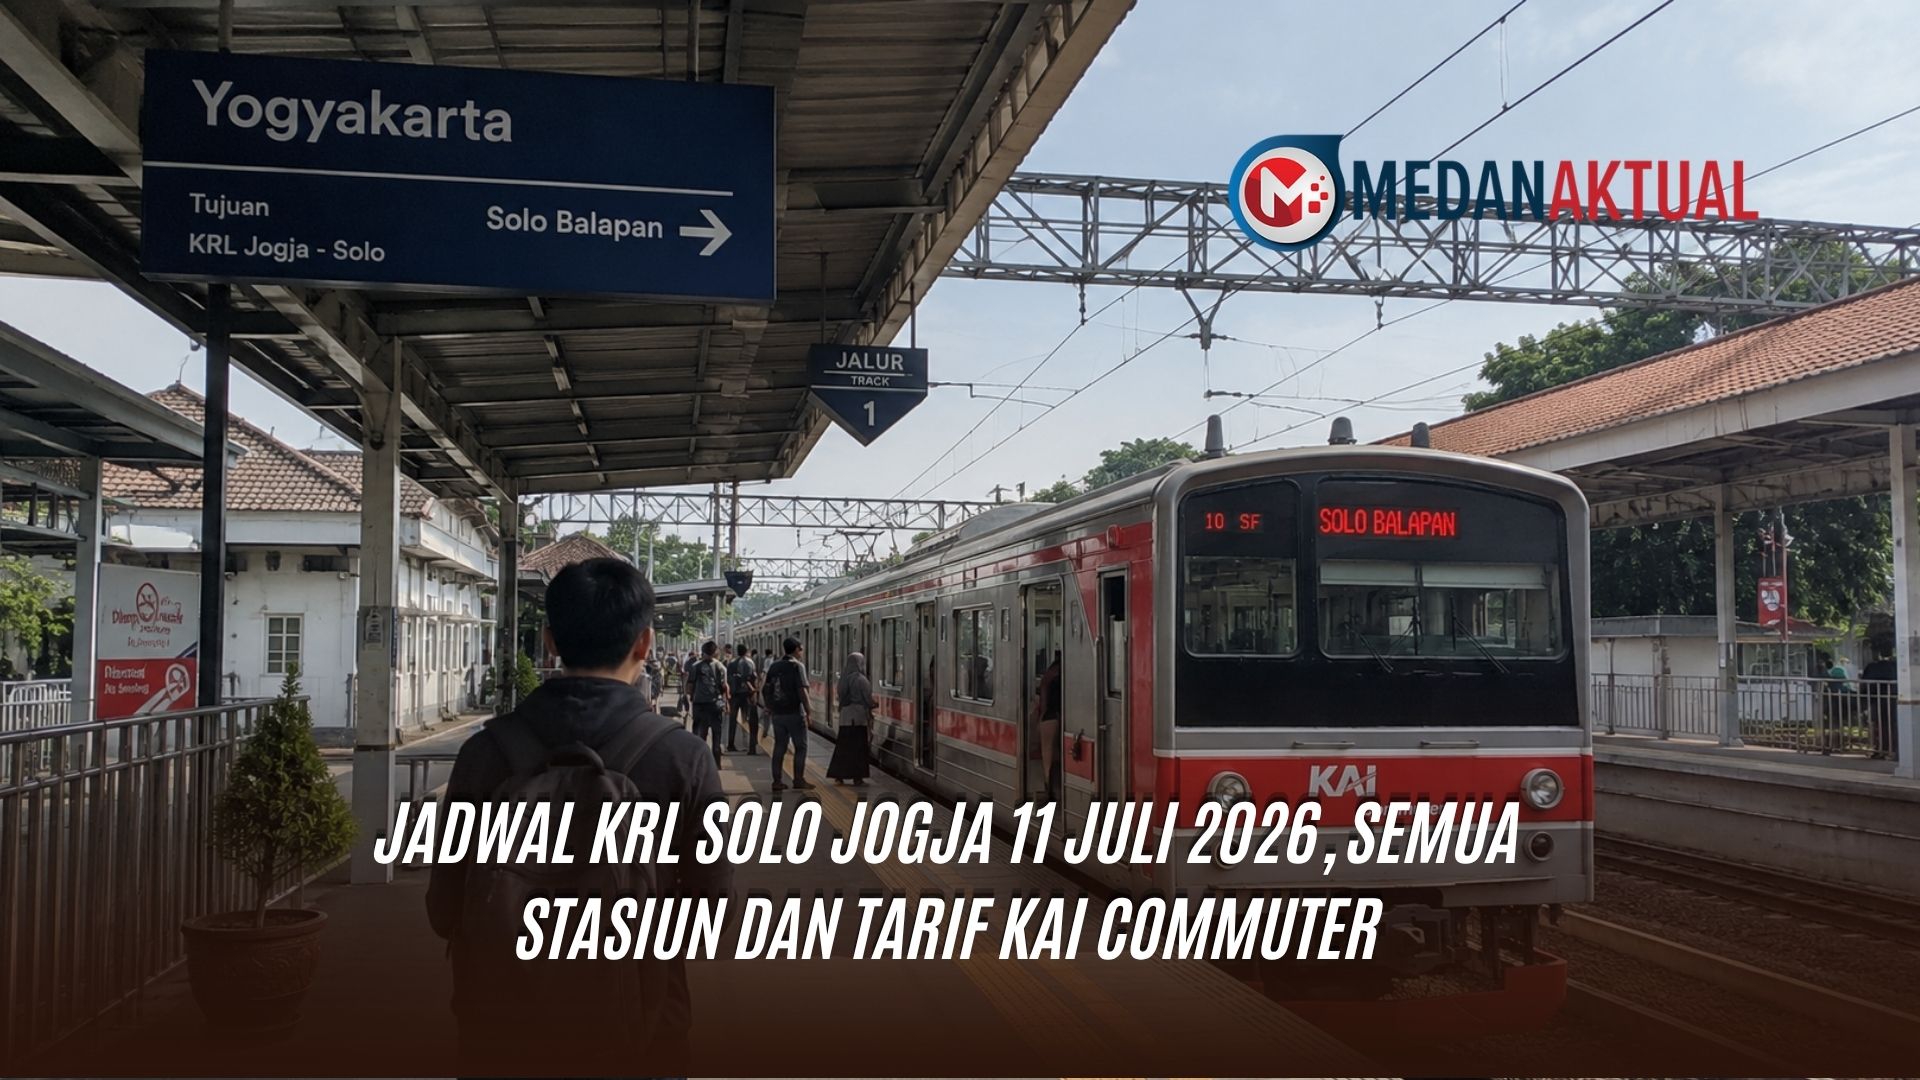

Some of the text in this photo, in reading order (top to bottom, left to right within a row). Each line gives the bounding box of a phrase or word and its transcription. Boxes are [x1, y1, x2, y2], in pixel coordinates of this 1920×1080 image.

[192, 80, 512, 143] Yogyakarta
[189, 193, 269, 220] Tujuan
[486, 205, 663, 242] Solo Balapan
[189, 233, 238, 255] KRL
[244, 235, 309, 263] Jogja
[333, 239, 385, 262] Solo
[836, 352, 904, 371] JALUR
[851, 375, 890, 387] TRACK
[863, 400, 875, 427] 1
[1205, 513, 1262, 529] 10 SF
[1319, 508, 1456, 537] SOLO BALAPAN
[1308, 765, 1377, 797] KAI
